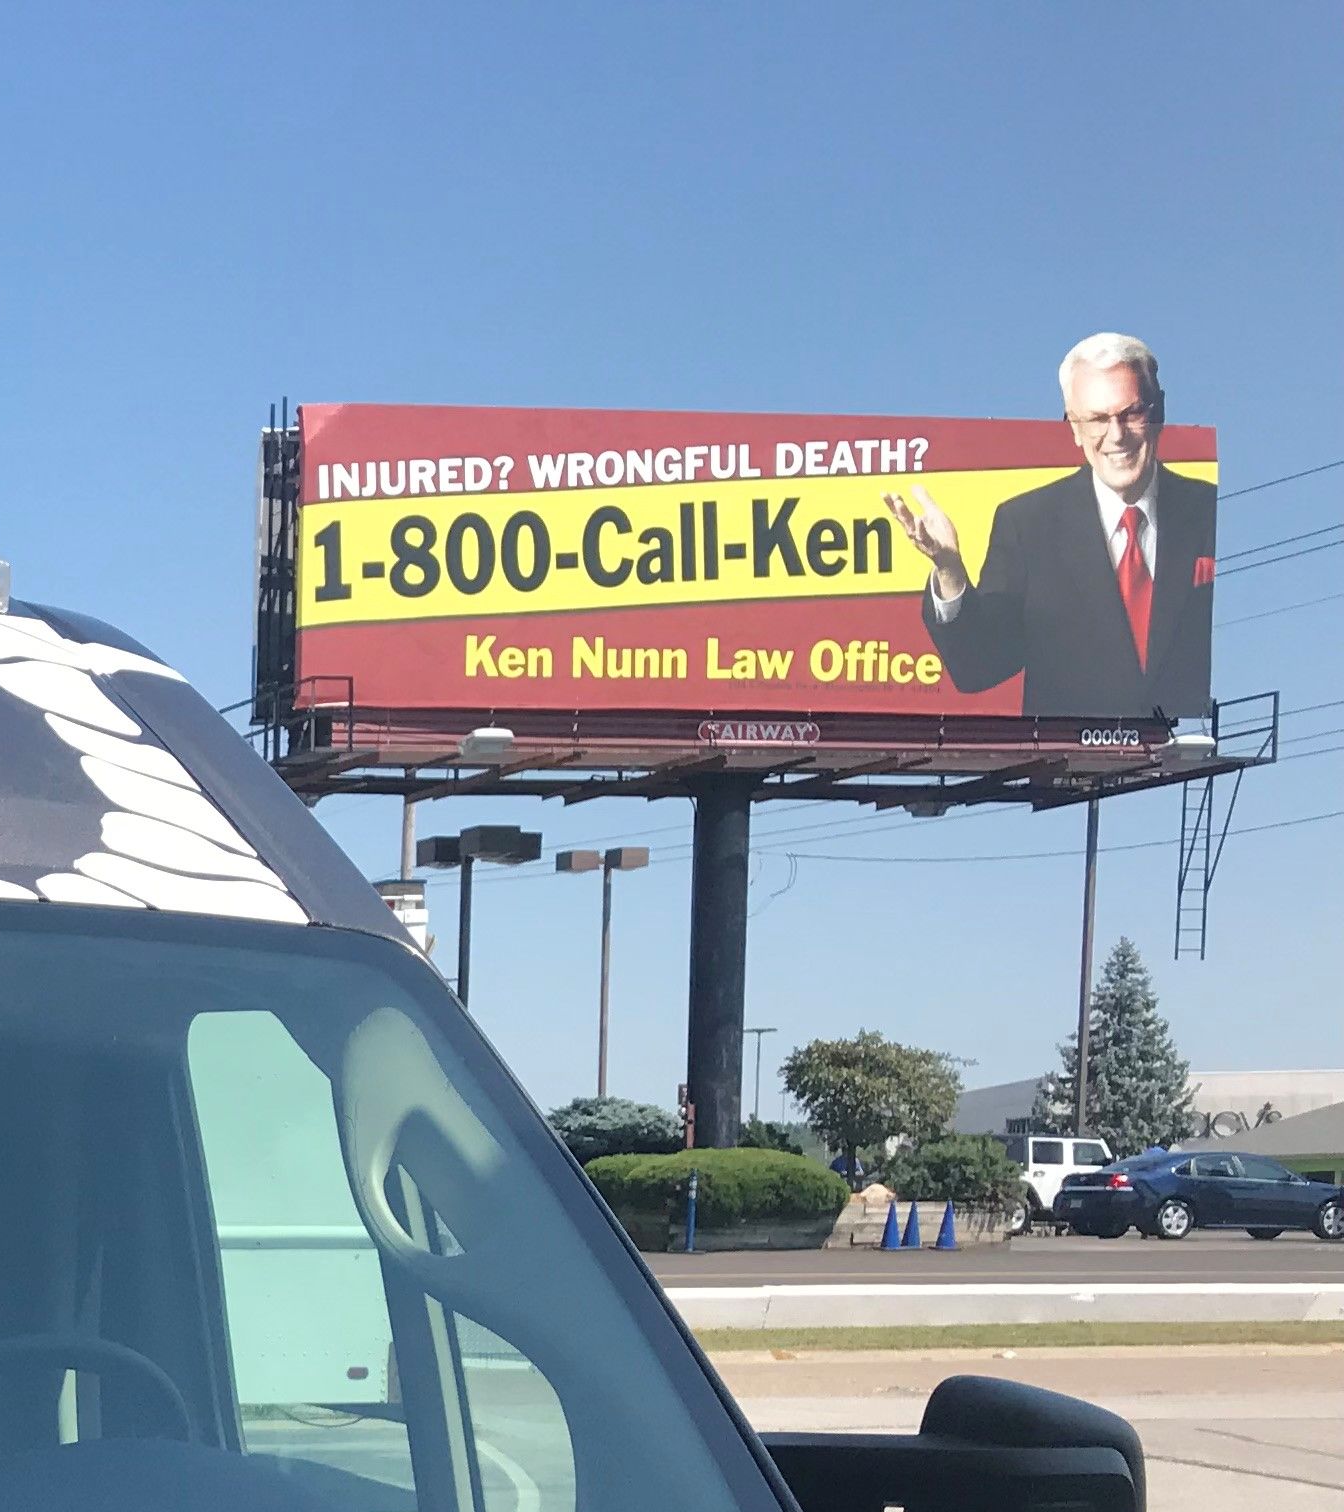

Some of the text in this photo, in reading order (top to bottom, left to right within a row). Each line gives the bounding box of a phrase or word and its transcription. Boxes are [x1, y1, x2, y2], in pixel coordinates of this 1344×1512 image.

[318, 437, 929, 499] INJURED? WRONGFUL DEATH?
[314, 497, 892, 602] 1-800-Call-Ken
[465, 635, 943, 684] Ken Nunn Law Office
[1081, 729, 1139, 745] 000073
